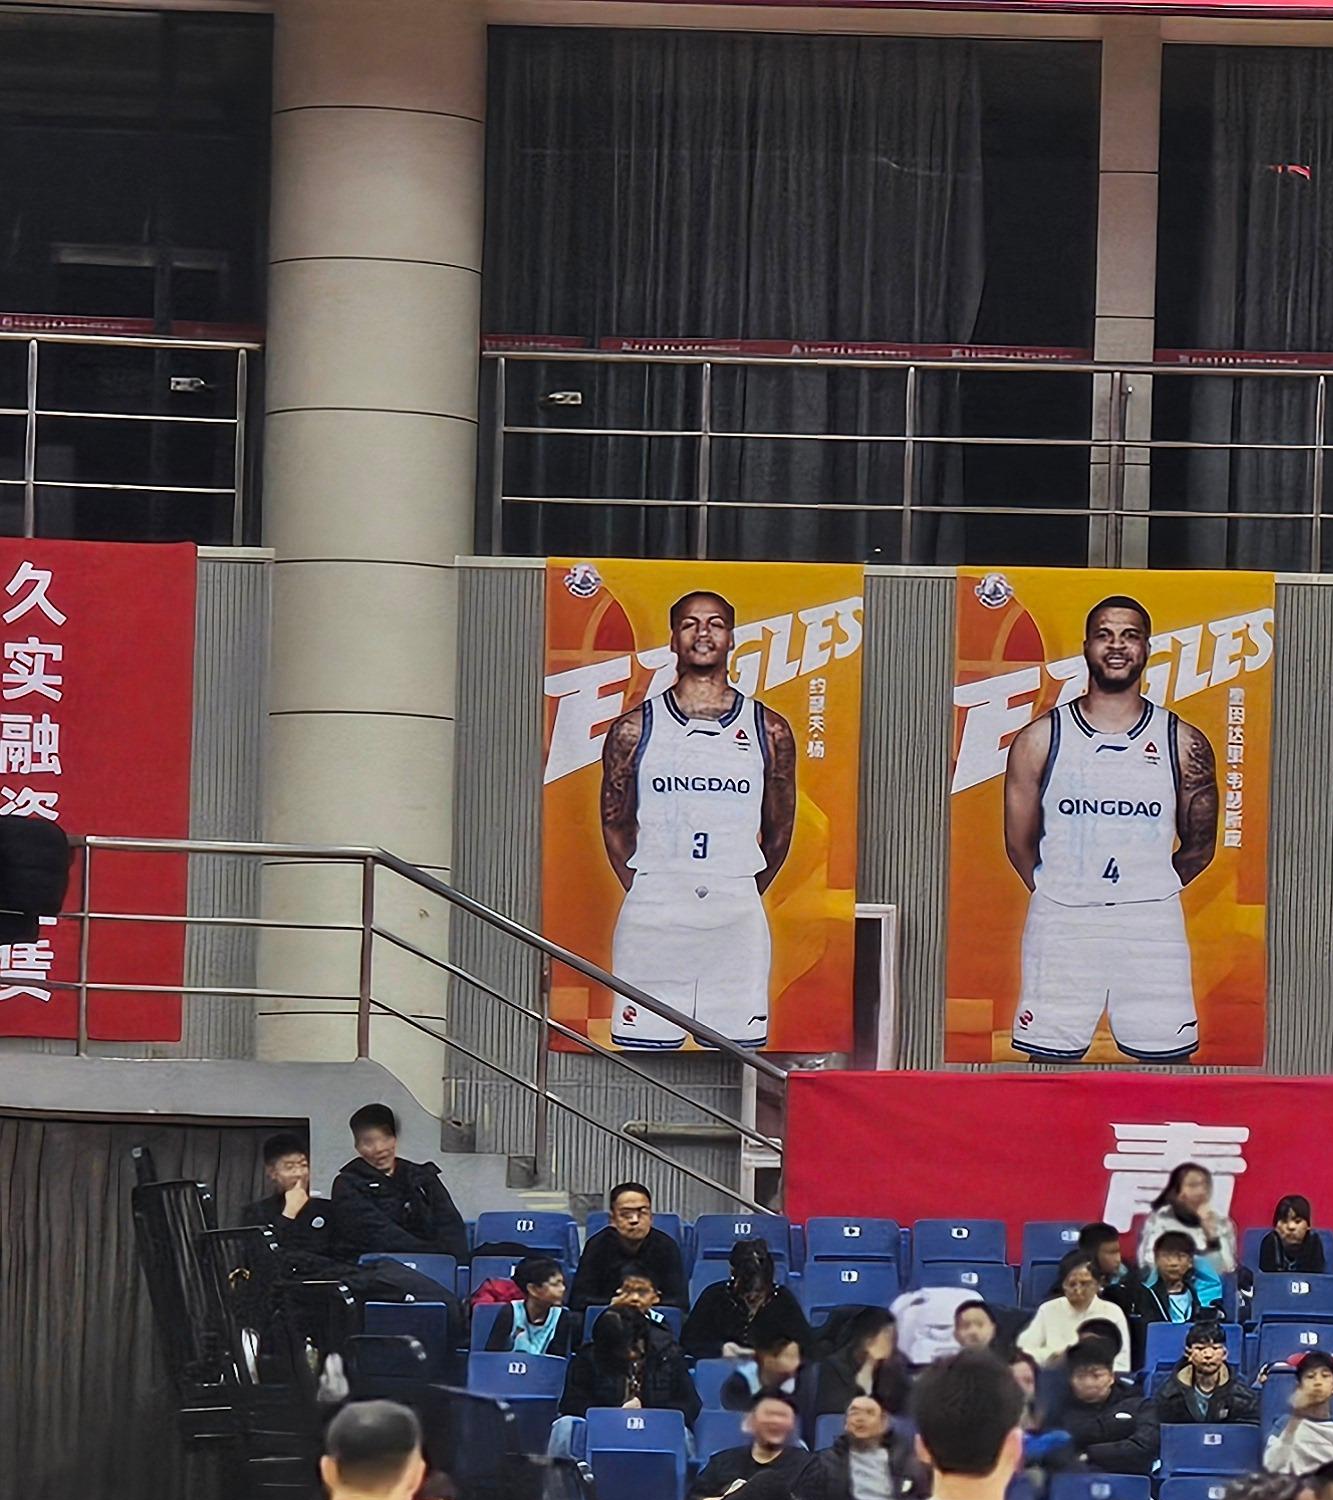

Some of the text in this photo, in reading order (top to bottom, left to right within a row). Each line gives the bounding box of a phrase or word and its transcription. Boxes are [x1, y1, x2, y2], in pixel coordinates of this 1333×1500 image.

[0, 561, 68, 1002] 久实融赁
[652, 777, 751, 795] QINGDAO
[1058, 798, 1162, 817] QINGDAO
[692, 832, 708, 859] 3
[1102, 857, 1120, 883] 4
